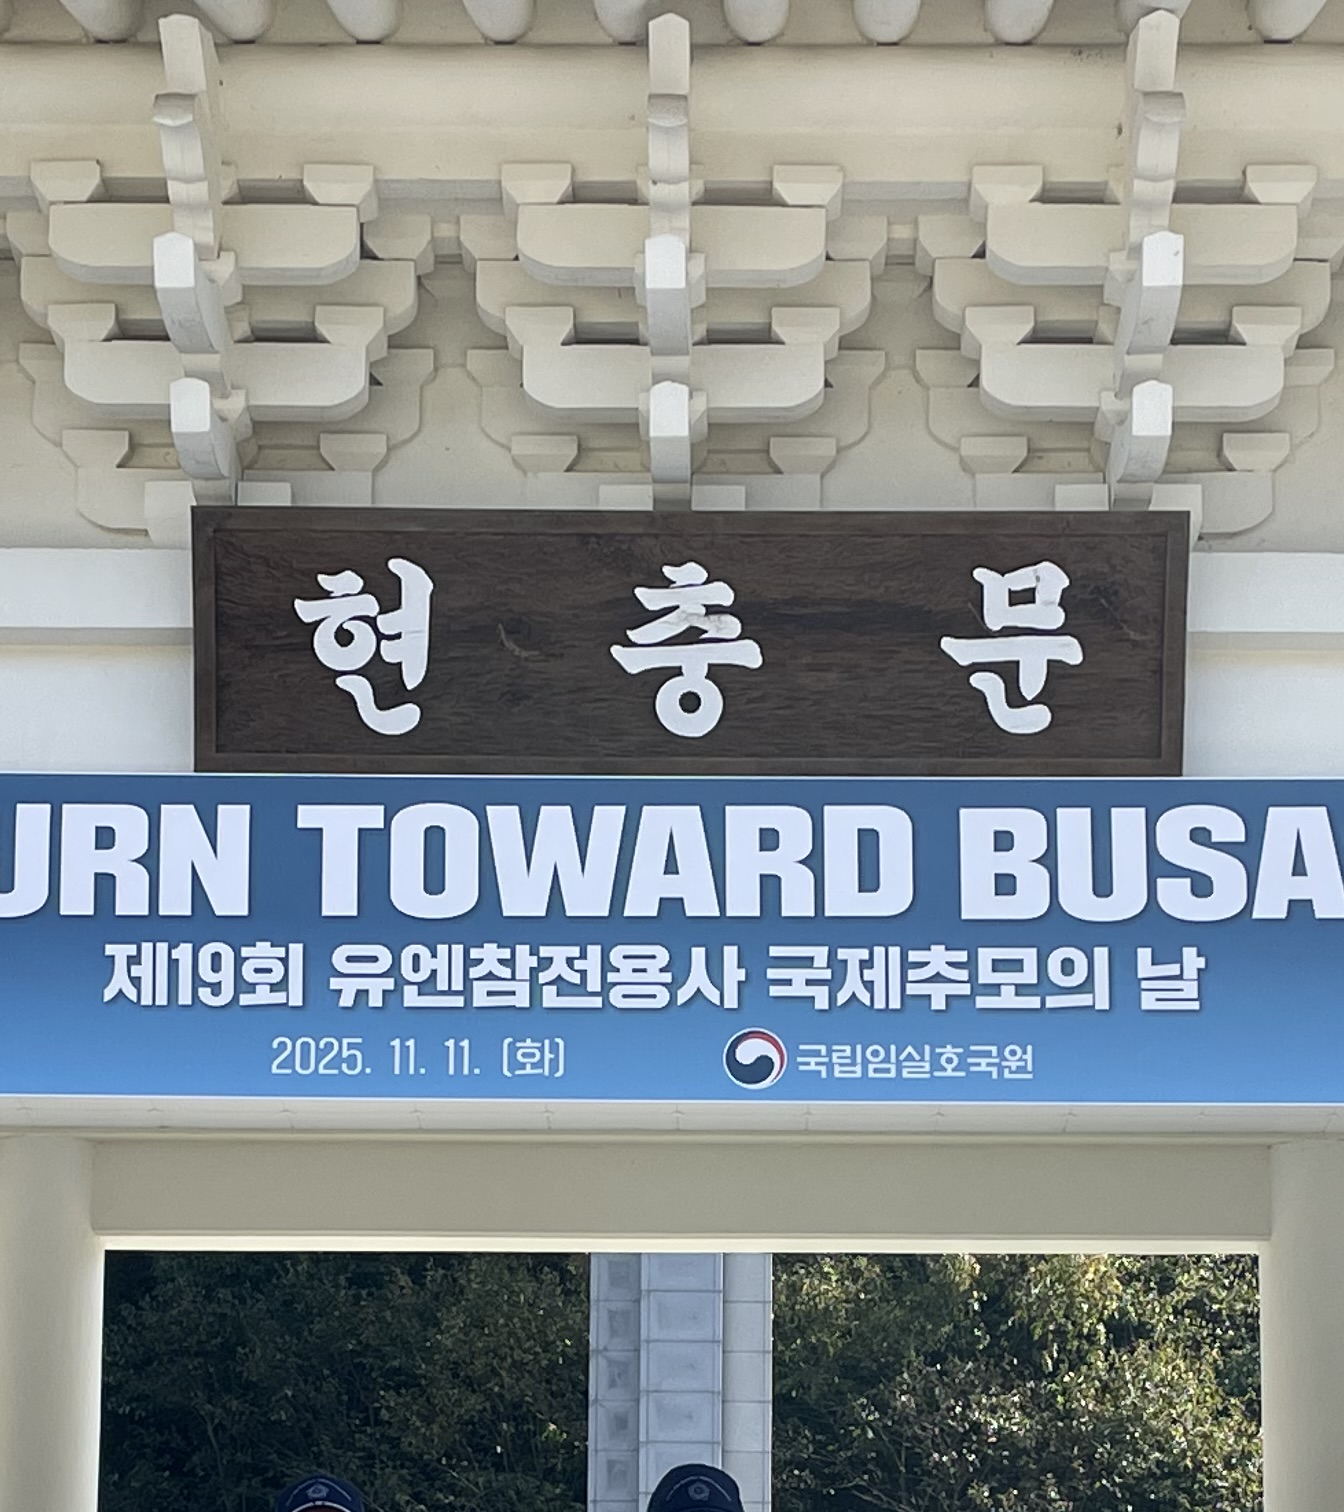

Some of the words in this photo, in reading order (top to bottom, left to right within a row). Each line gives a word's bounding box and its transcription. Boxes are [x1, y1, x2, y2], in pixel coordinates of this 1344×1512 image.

[294, 557, 1084, 738] 현충문
[296, 803, 914, 919] TOWARD
[102, 940, 303, 1008] 제19회
[329, 942, 746, 1010] 유엔참전용사
[765, 944, 1110, 1012] 국제추모의
[1135, 946, 1206, 1012] 날
[271, 1036, 371, 1076] 2025.
[389, 1037, 426, 1076] 11.
[444, 1037, 481, 1076] 11.
[796, 1043, 1034, 1081] 국립임실호국원
